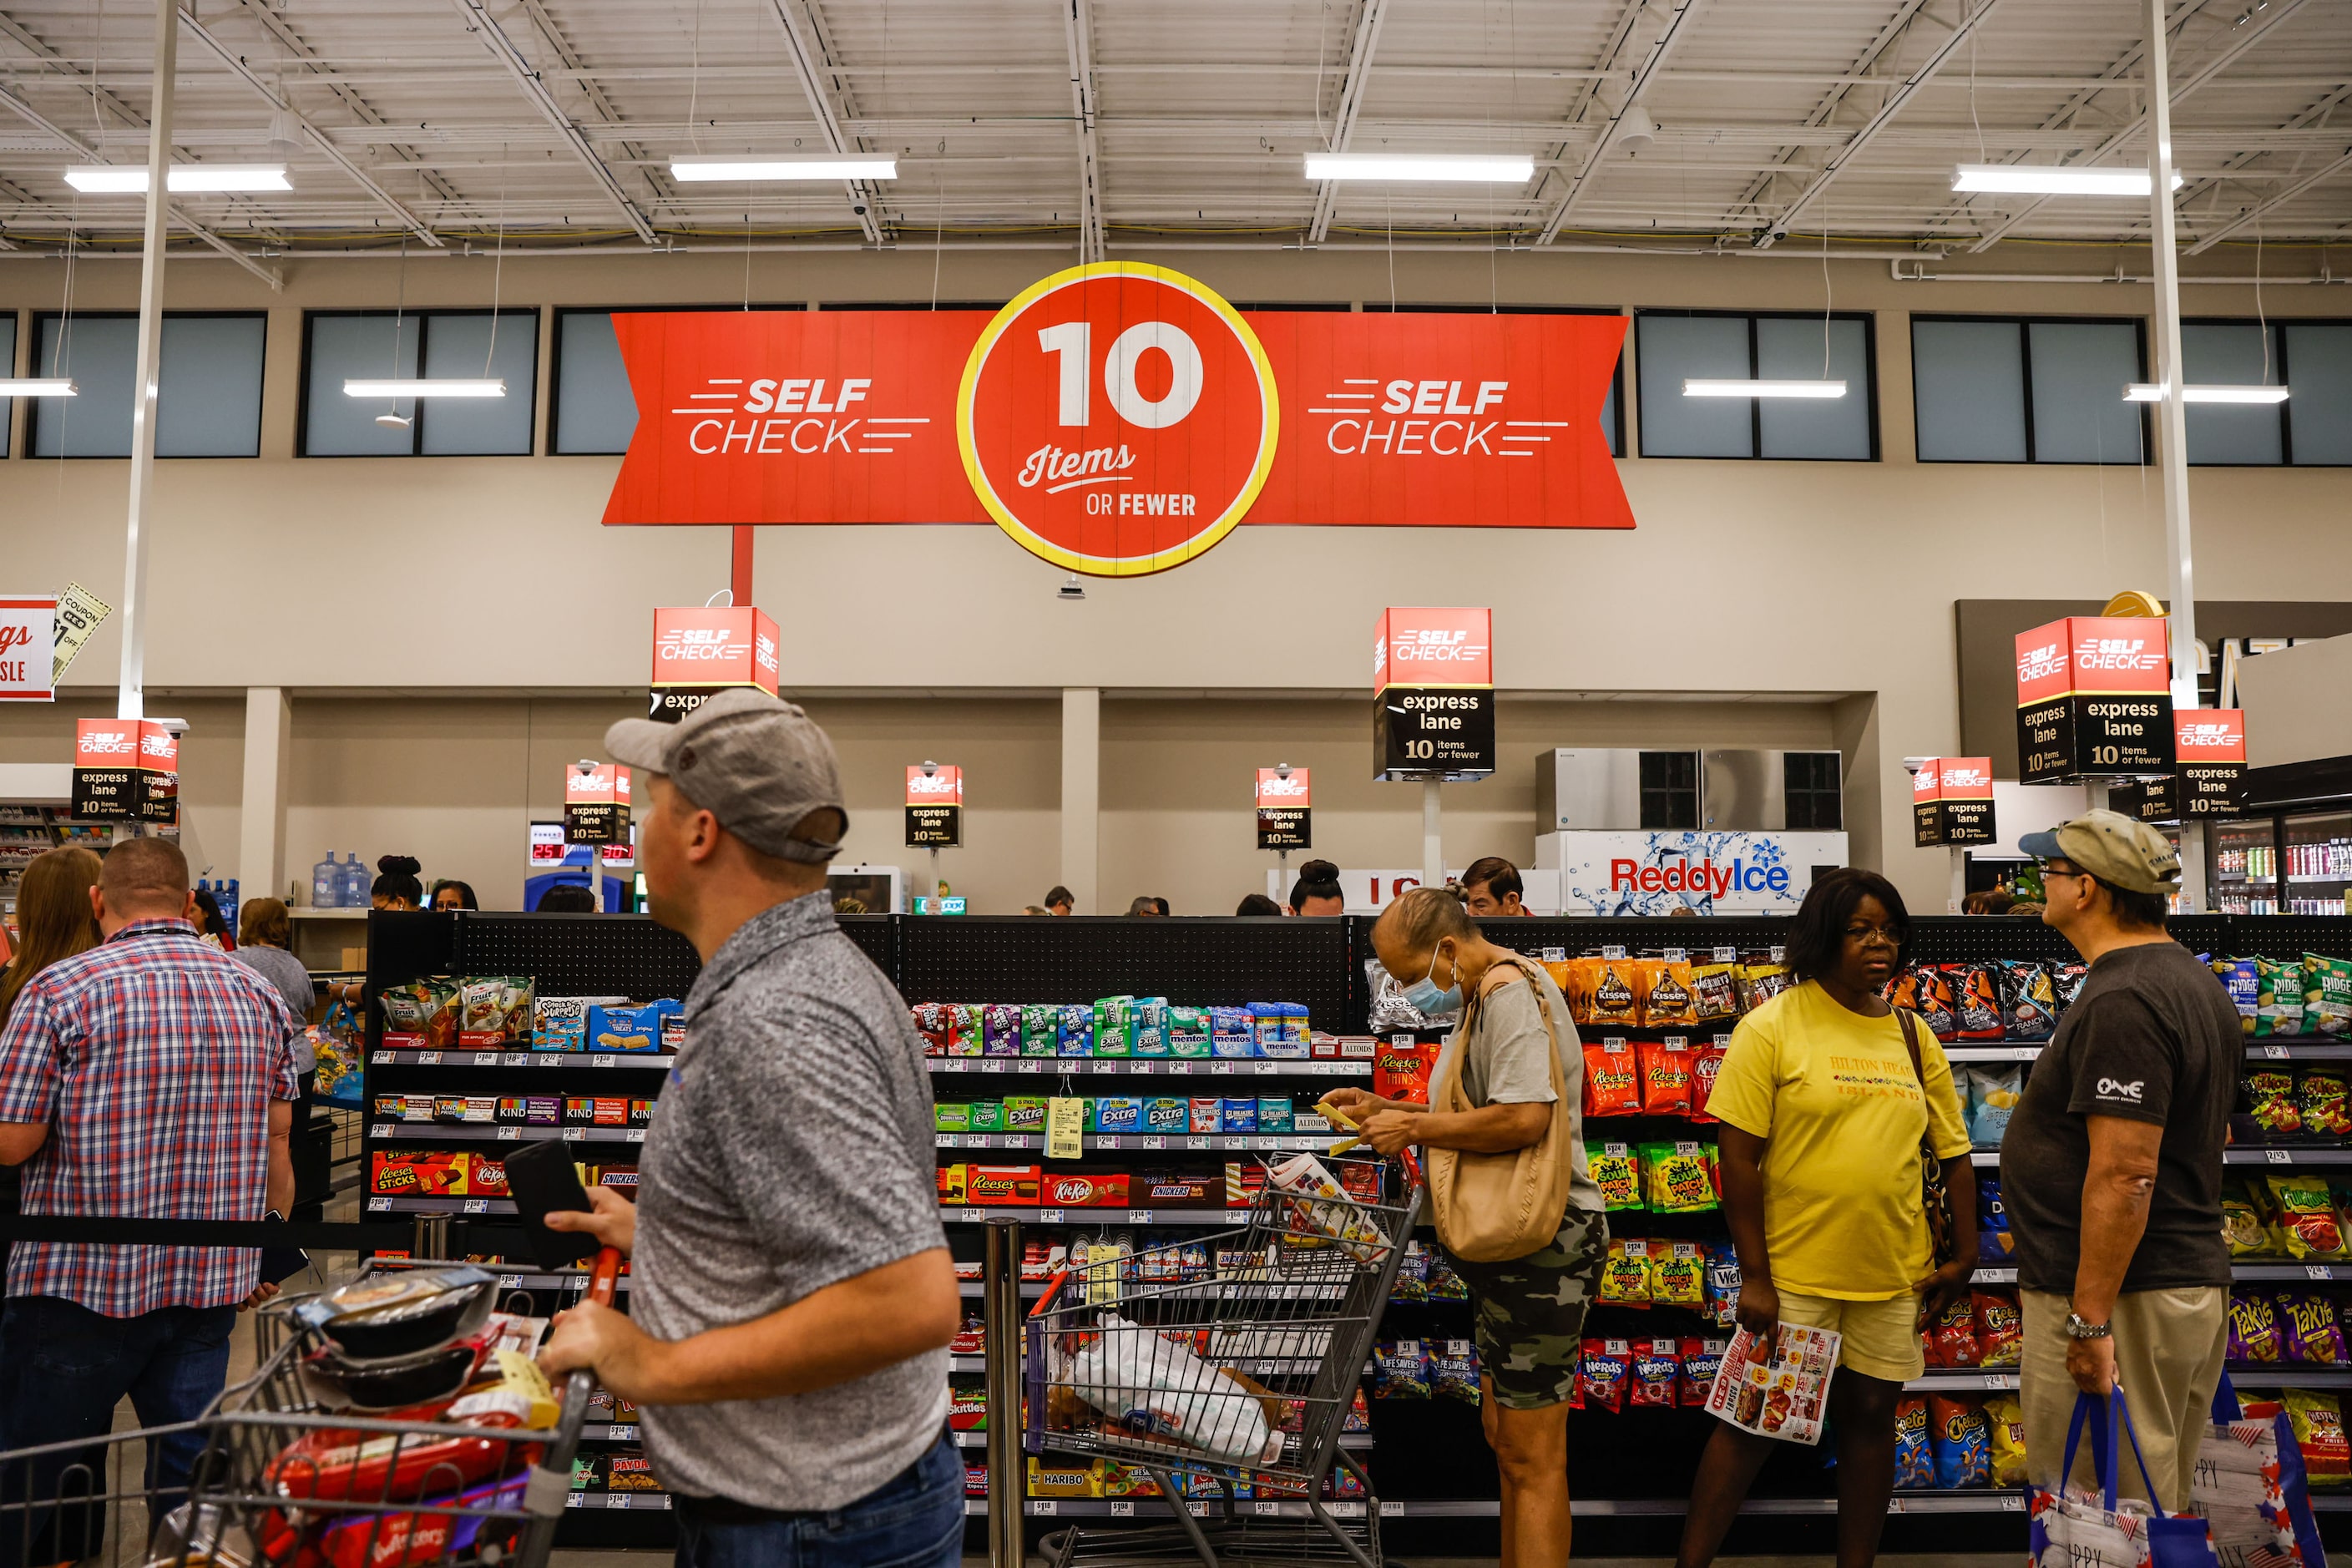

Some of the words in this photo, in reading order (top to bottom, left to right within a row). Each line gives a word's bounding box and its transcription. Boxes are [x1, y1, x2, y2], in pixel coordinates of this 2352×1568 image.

[1038, 321, 1203, 429] 10
[743, 378, 872, 414] SELF
[1380, 379, 1509, 416] SELF
[688, 418, 861, 455] CHECK
[1327, 419, 1500, 457] CHECK
[1017, 444, 1136, 488] Items
[1086, 493, 1113, 516] OR
[1119, 493, 1196, 517] FEWER
[65, 598, 98, 623] COUPON
[63, 636, 78, 647] OFF
[681, 630, 731, 644] SELF
[1417, 630, 1467, 645] SELF
[661, 645, 726, 660] CHECK
[1397, 645, 1462, 660] CHECK
[2098, 640, 2144, 655] SELF
[2030, 644, 2056, 665] SELF
[2079, 655, 2141, 669] CHECK
[2020, 660, 2055, 682] CHECK
[665, 694, 709, 711] expr
[1403, 695, 1479, 712] express
[2025, 706, 2066, 727] express
[2087, 703, 2158, 719] express
[1420, 713, 1461, 730] lane
[2104, 720, 2143, 736] lane
[2035, 727, 2056, 743] lane
[2195, 724, 2229, 735] SELF
[94, 733, 125, 743] SELF
[2181, 735, 2225, 746] CHECK
[81, 743, 122, 753] CHECK
[1405, 740, 1434, 759] 10
[1437, 741, 1464, 749] items
[1451, 750, 1479, 759] fewer
[2028, 753, 2043, 772] 10
[2044, 751, 2059, 760] items
[2092, 746, 2118, 764] 10
[2122, 746, 2147, 755] items
[2134, 756, 2162, 764] fewer
[2044, 761, 2051, 769] or
[2051, 758, 2067, 767] fewer
[82, 773, 128, 784] express
[143, 775, 172, 787] express
[2186, 769, 2238, 780] express
[1944, 777, 1977, 787] CHECK
[2198, 781, 2227, 792] lane
[92, 785, 117, 795] lane
[149, 787, 165, 798] lane
[2147, 785, 2164, 797] lane
[81, 801, 99, 813] 10
[142, 802, 154, 815] 10
[572, 807, 609, 817] express
[1948, 805, 1987, 813] express
[2142, 802, 2153, 817] 10
[2189, 799, 2209, 812] 10
[579, 816, 600, 825] lane
[921, 818, 942, 827] lane
[1266, 812, 1303, 821] express
[1957, 814, 1980, 823] lane
[1274, 821, 1295, 829] lane
[573, 829, 587, 839] 10
[913, 832, 928, 841] 10
[1267, 834, 1282, 843] 10
[1950, 828, 1965, 838] 10
[534, 844, 564, 858] 251
[603, 845, 633, 858] 301
[1611, 858, 1789, 899] ReddyIce
[470, 991, 493, 1003] Fruit
[1925, 1012, 1947, 1023] NACHO
[2017, 1016, 2045, 1030] RANCH
[1100, 1035, 1124, 1047] Extra
[1138, 1035, 1161, 1047] Extra
[1213, 1035, 1251, 1044] mentos
[1379, 1055, 1420, 1068] Reese's
[1830, 1056, 1879, 1071] HILTON
[1882, 1060, 1913, 1078] HEAD
[1594, 1071, 1633, 1085] Reese's
[1648, 1068, 1689, 1082] Reese's
[1838, 1085, 1920, 1100] ISLAND
[2097, 1078, 2144, 1099] ONE
[500, 1109, 526, 1117] KIND
[567, 1110, 593, 1118] KIND
[975, 1112, 995, 1122] Extra
[1009, 1108, 1044, 1124] Extra
[1101, 1108, 1137, 1125] Extra
[1149, 1108, 1185, 1125] Extra
[379, 1166, 413, 1181] Reese's
[603, 1174, 639, 1184] SNICKERS
[1598, 1169, 1628, 1181] SOUR
[1668, 1170, 1700, 1184] SOUR
[971, 1175, 1015, 1189] Reese's
[1600, 1179, 1631, 1192] PATCH
[1670, 1179, 1704, 1195] PATCH
[1055, 1182, 1090, 1200] KitKat
[1152, 1186, 1189, 1196] SNICKERS
[1614, 1267, 1641, 1275] SOUR
[1663, 1267, 1691, 1275] SOUR
[1613, 1275, 1643, 1283] PATCH
[1663, 1275, 1693, 1284] PATCH
[2229, 1302, 2273, 1343] Takis
[2286, 1302, 2334, 1340] Takis
[1453, 1342, 1460, 1350] $1
[1709, 1342, 1717, 1350] $1
[1382, 1359, 1395, 1368] LIFE
[1396, 1359, 1419, 1369] SAVERS
[1447, 1360, 1469, 1371] SAVERS
[1722, 1348, 1737, 1377] GRAND
[1386, 1369, 1416, 1378] GUMMIES
[948, 1403, 986, 1414] Skittles
[1947, 1411, 1985, 1441] Cheetos
[1044, 1474, 1083, 1485] HARIBO
[1189, 1482, 1220, 1495] AIRHEADS
